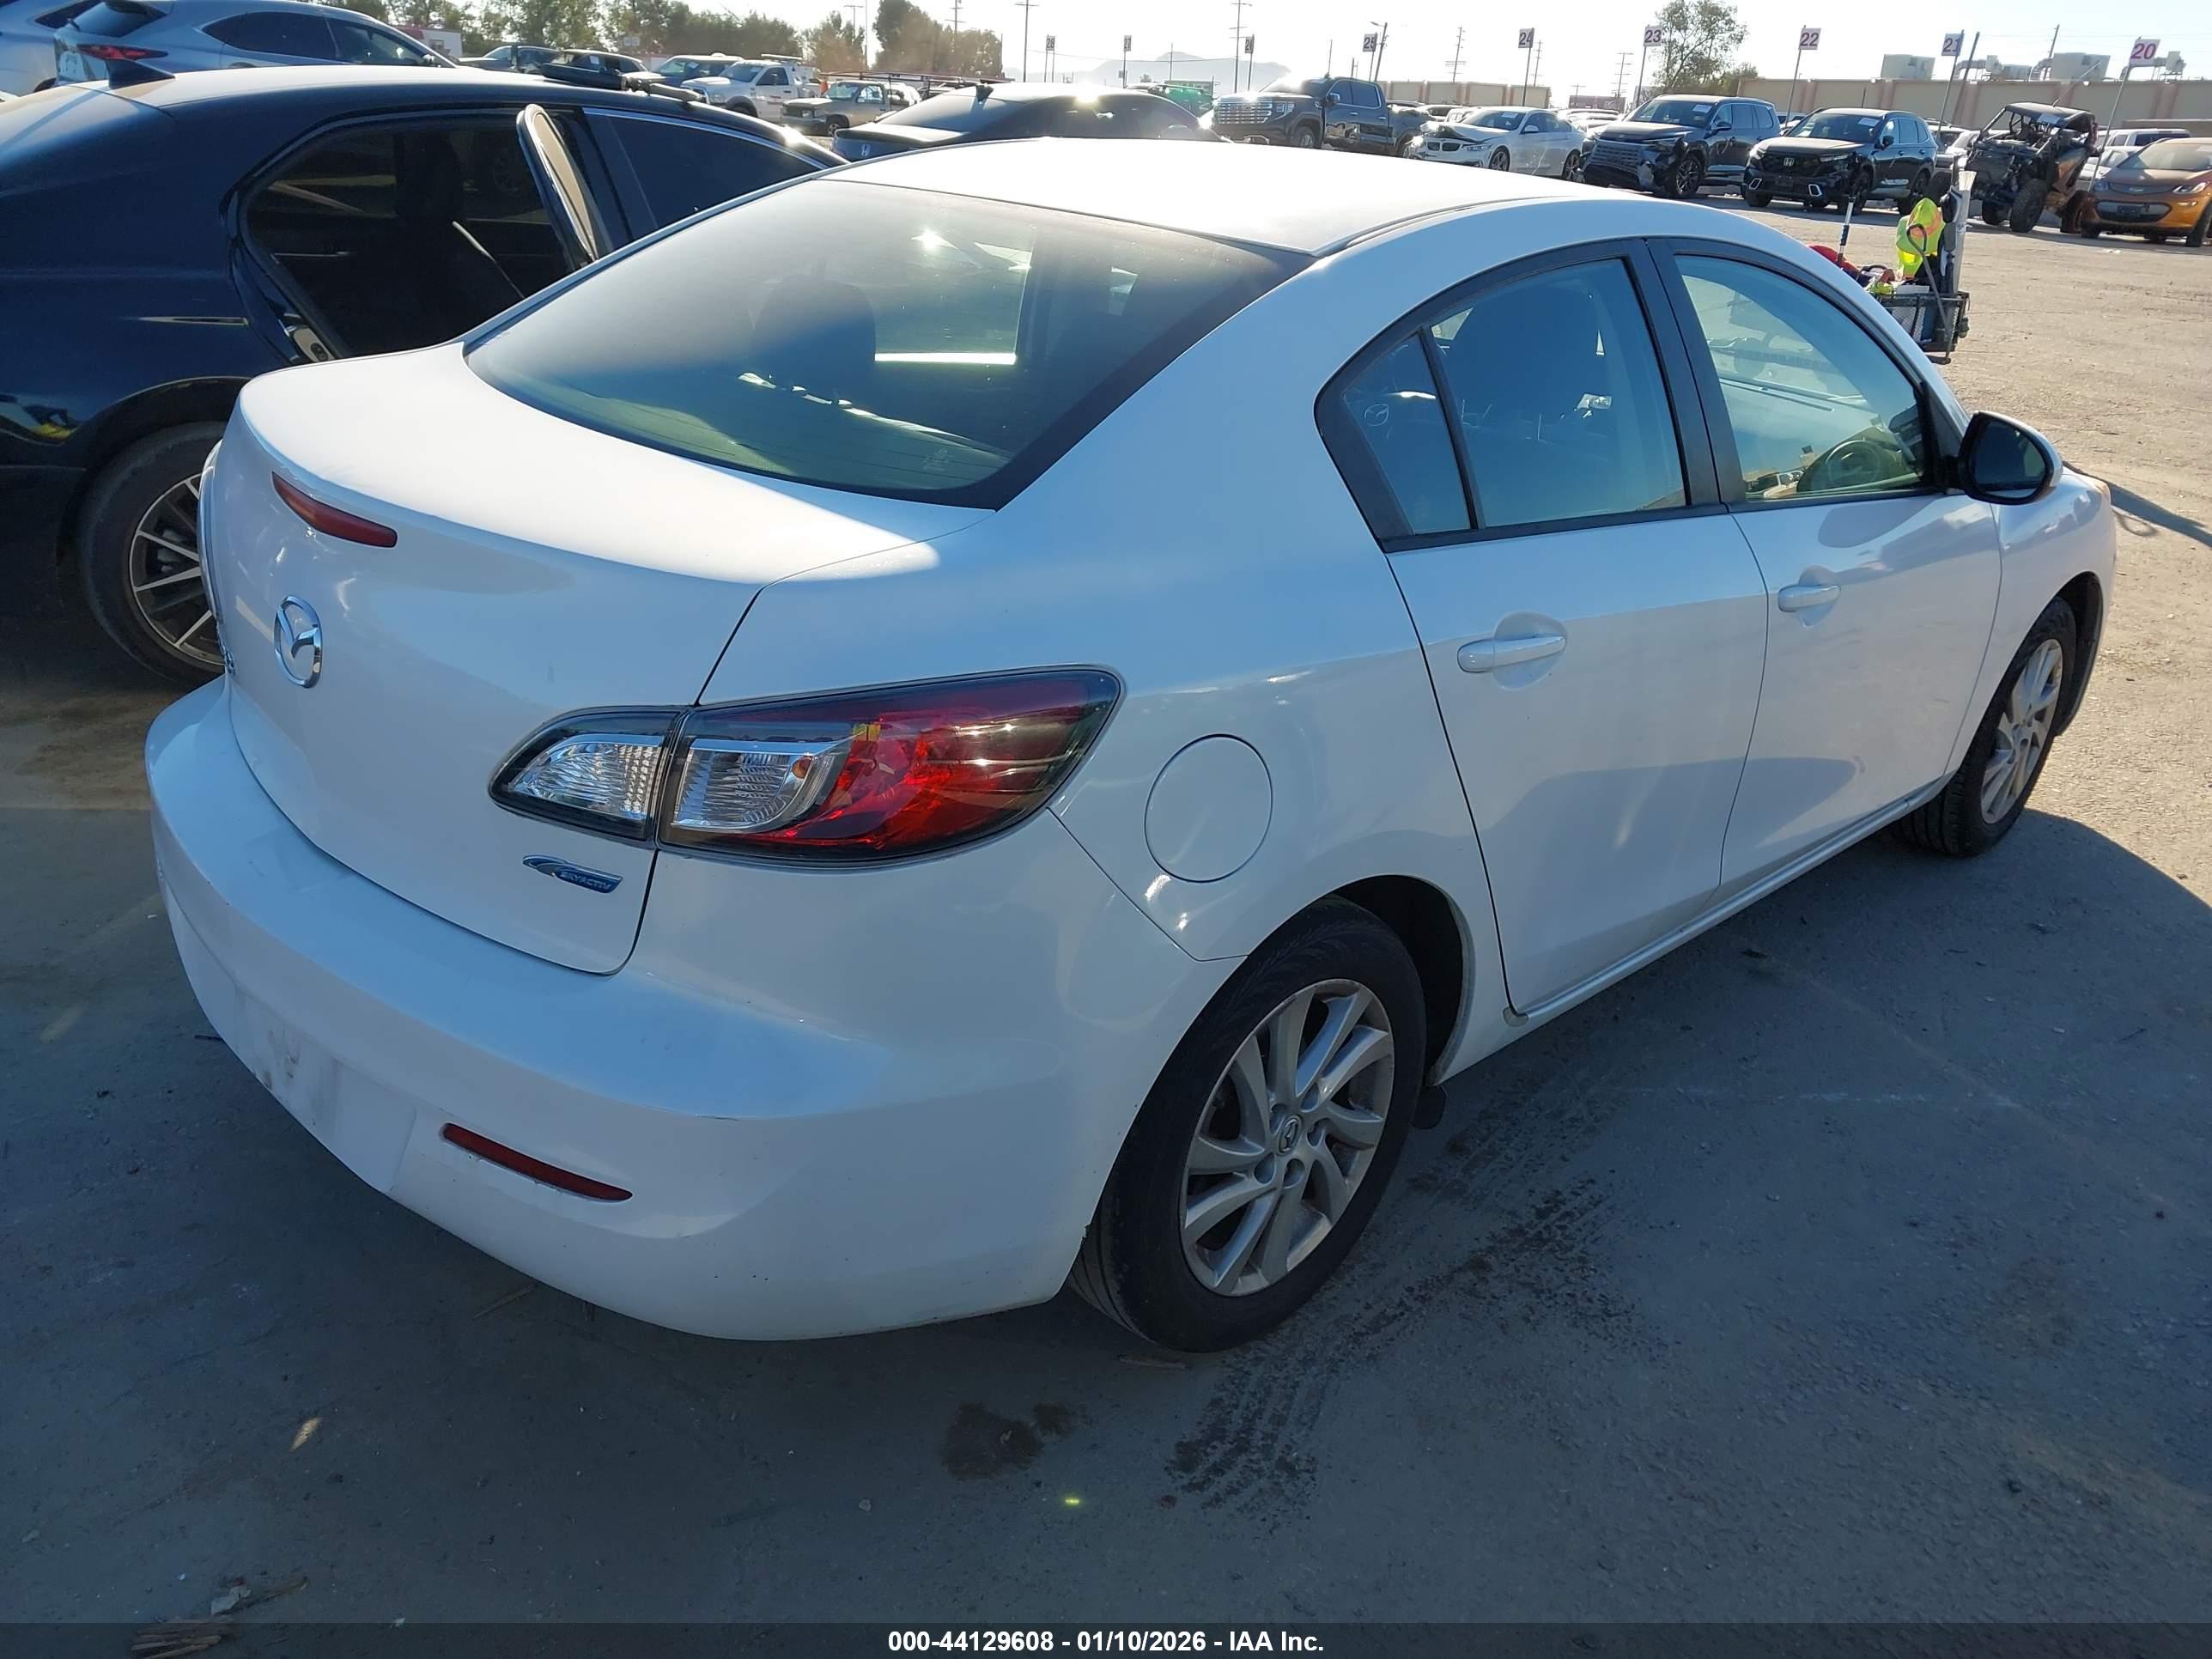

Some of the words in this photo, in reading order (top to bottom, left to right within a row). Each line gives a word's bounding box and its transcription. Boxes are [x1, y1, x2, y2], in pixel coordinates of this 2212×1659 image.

[1519, 33, 1532, 46] 24
[1644, 29, 1662, 43] 23
[1800, 33, 1820, 46] 22
[1046, 38, 1054, 49] 28
[1124, 38, 1131, 49] 27
[1942, 38, 1960, 52] 21
[2130, 43, 2157, 59] 20
[558, 870, 612, 890] SKYACTIV
